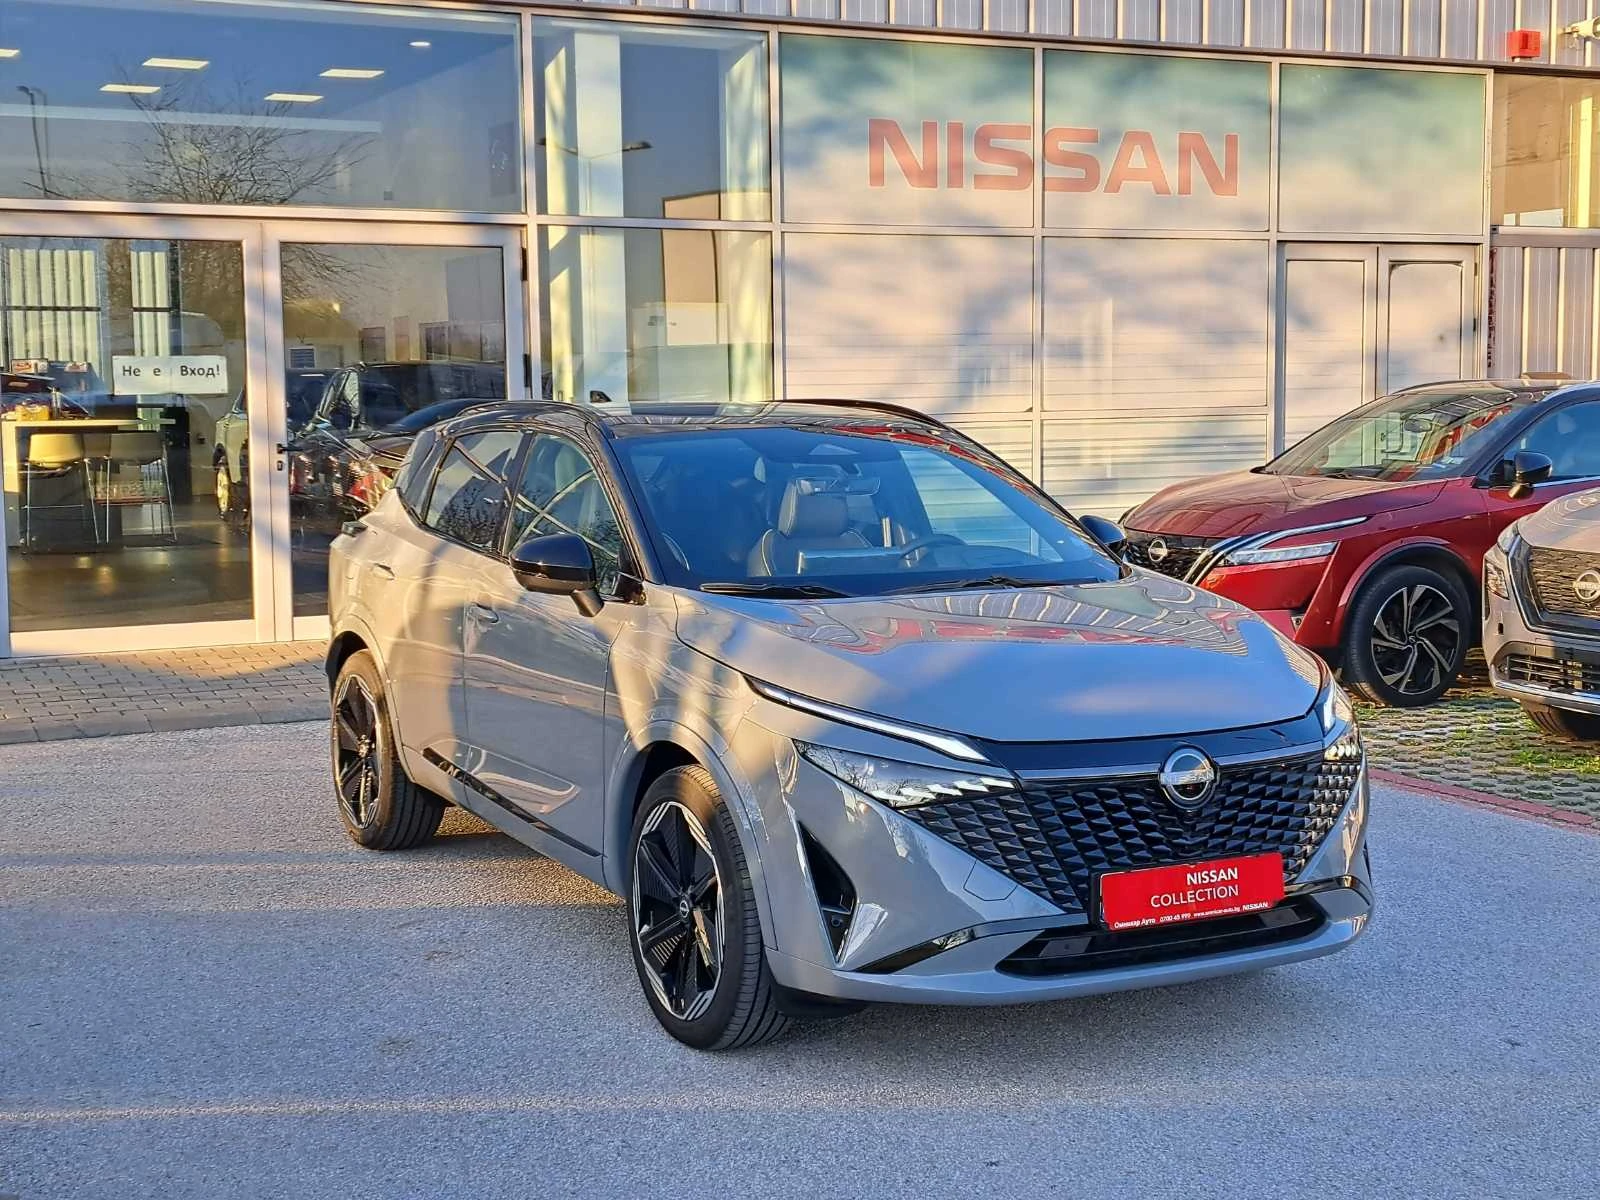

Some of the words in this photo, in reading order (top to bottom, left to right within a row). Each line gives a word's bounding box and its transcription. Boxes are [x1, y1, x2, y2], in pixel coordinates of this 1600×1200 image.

[868, 118, 1239, 197] NISSAN
[122, 365, 141, 376] Не
[153, 367, 161, 376] е
[180, 364, 220, 378] Вход!
[1187, 867, 1238, 886] NISSAN
[1151, 884, 1239, 908] COLLECTION
[1242, 902, 1268, 911] NISSAN
